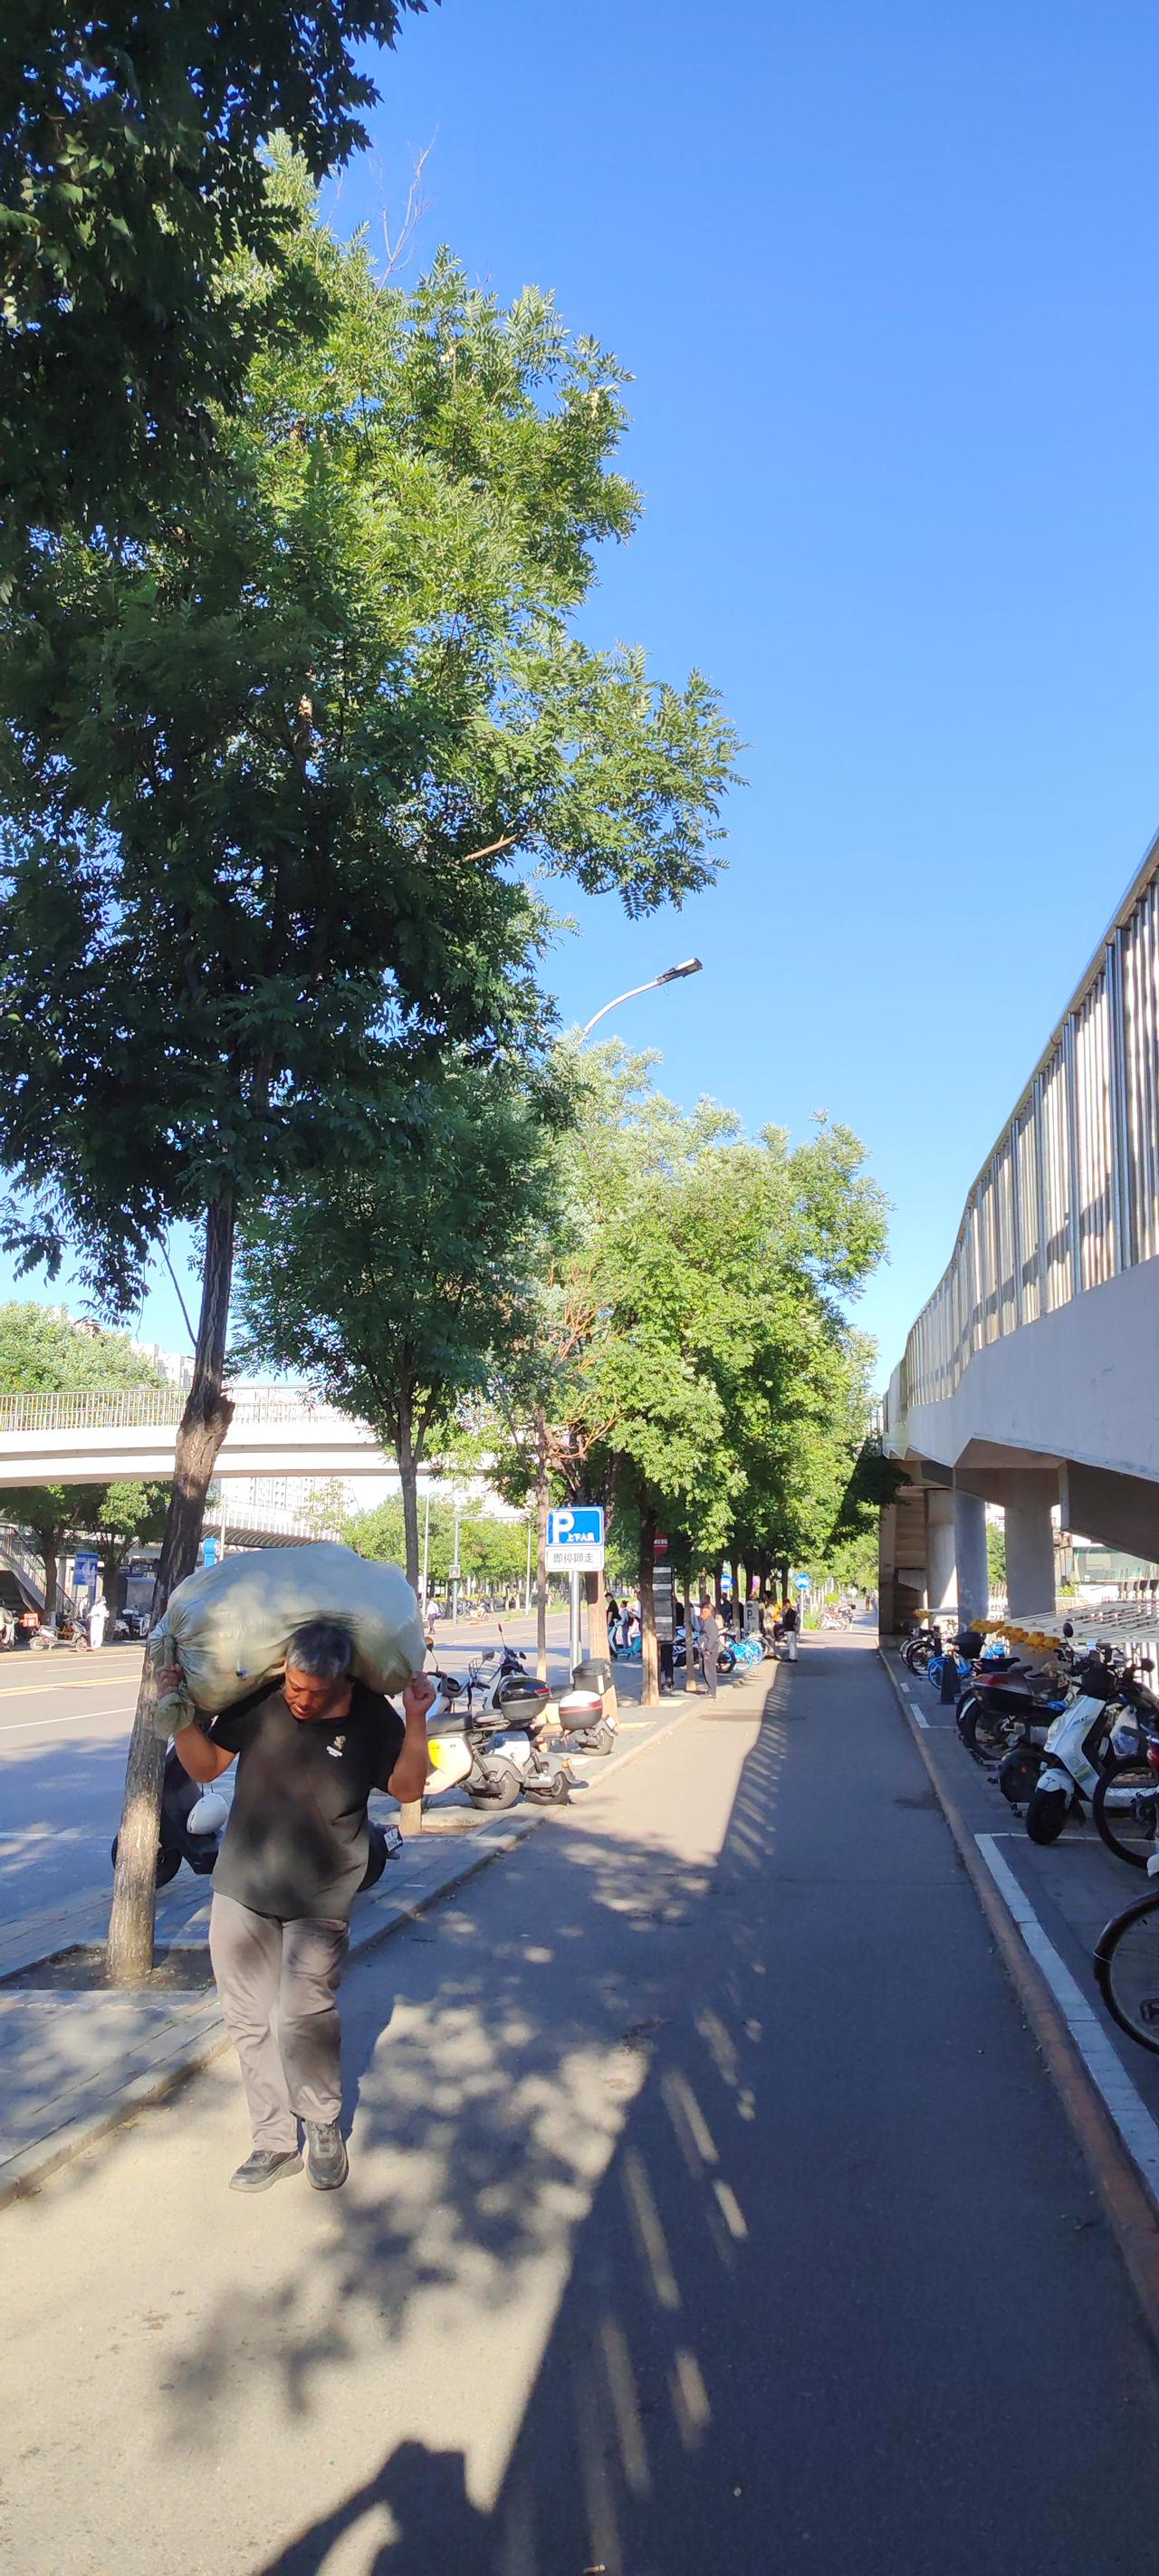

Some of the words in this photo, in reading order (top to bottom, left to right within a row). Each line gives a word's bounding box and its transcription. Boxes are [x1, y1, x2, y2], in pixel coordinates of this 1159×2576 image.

[552, 1512, 575, 1543] P
[553, 1552, 594, 1564] 即停即走
[747, 1610, 752, 1620] P
